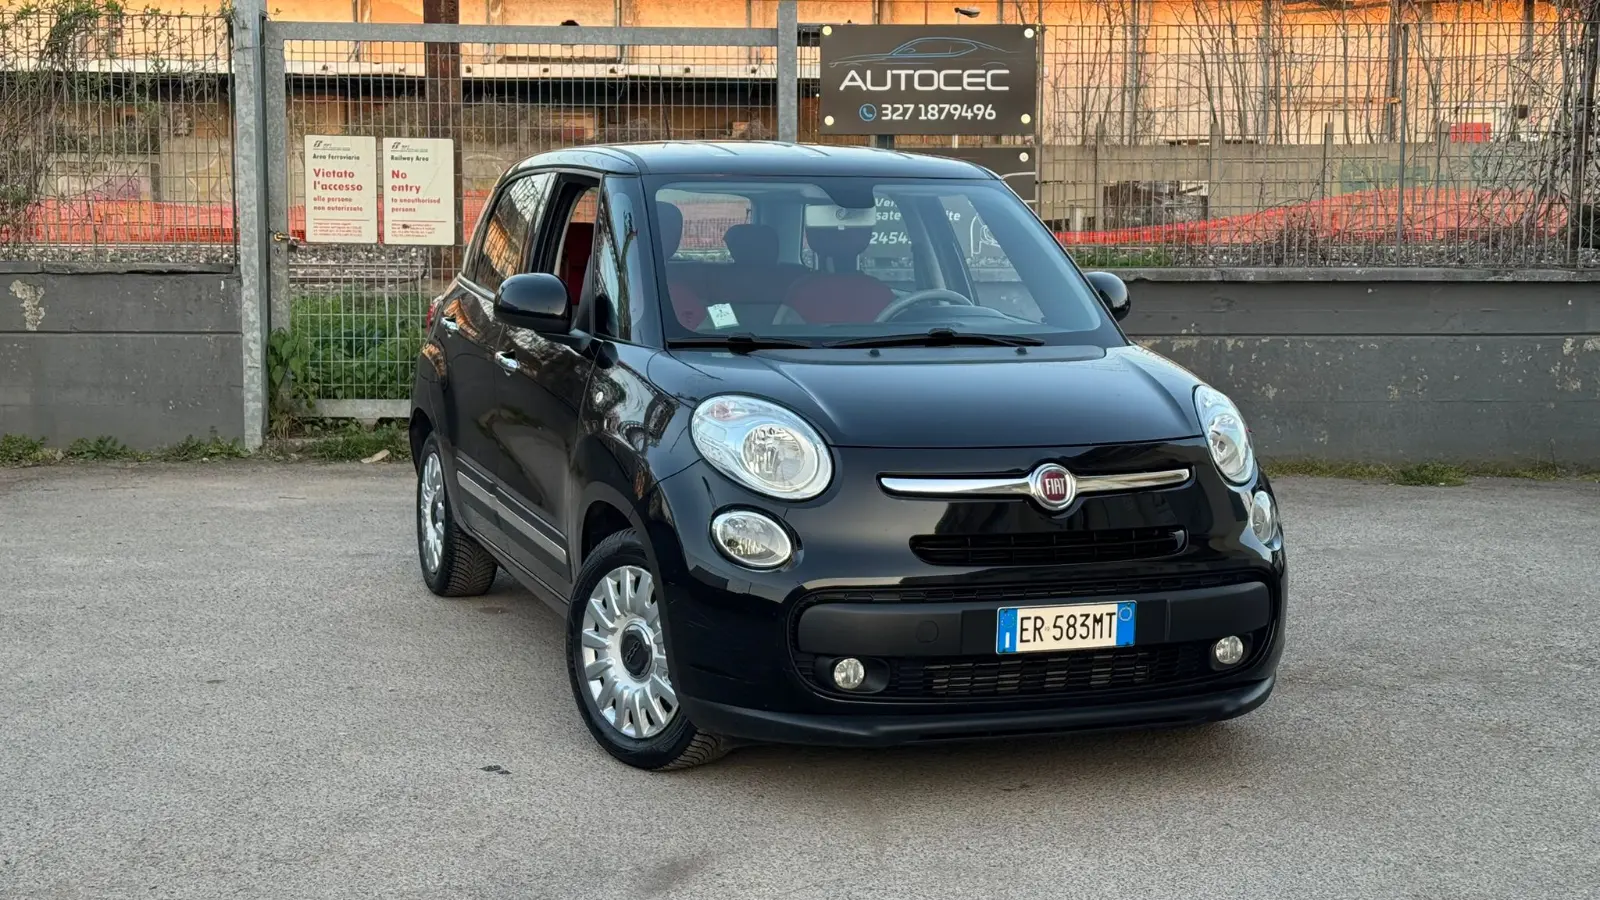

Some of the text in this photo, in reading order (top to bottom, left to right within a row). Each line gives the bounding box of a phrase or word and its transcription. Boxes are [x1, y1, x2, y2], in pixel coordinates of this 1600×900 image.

[839, 69, 1010, 91] AUTOCEC
[881, 103, 997, 120] 327 1879496
[313, 168, 355, 179] Vietato
[391, 169, 408, 179] No
[313, 180, 363, 191] l'accesso
[391, 184, 421, 194] entry
[1045, 478, 1065, 495] FIAT
[1019, 616, 1045, 643] ER
[1052, 612, 1117, 642] 583MT
